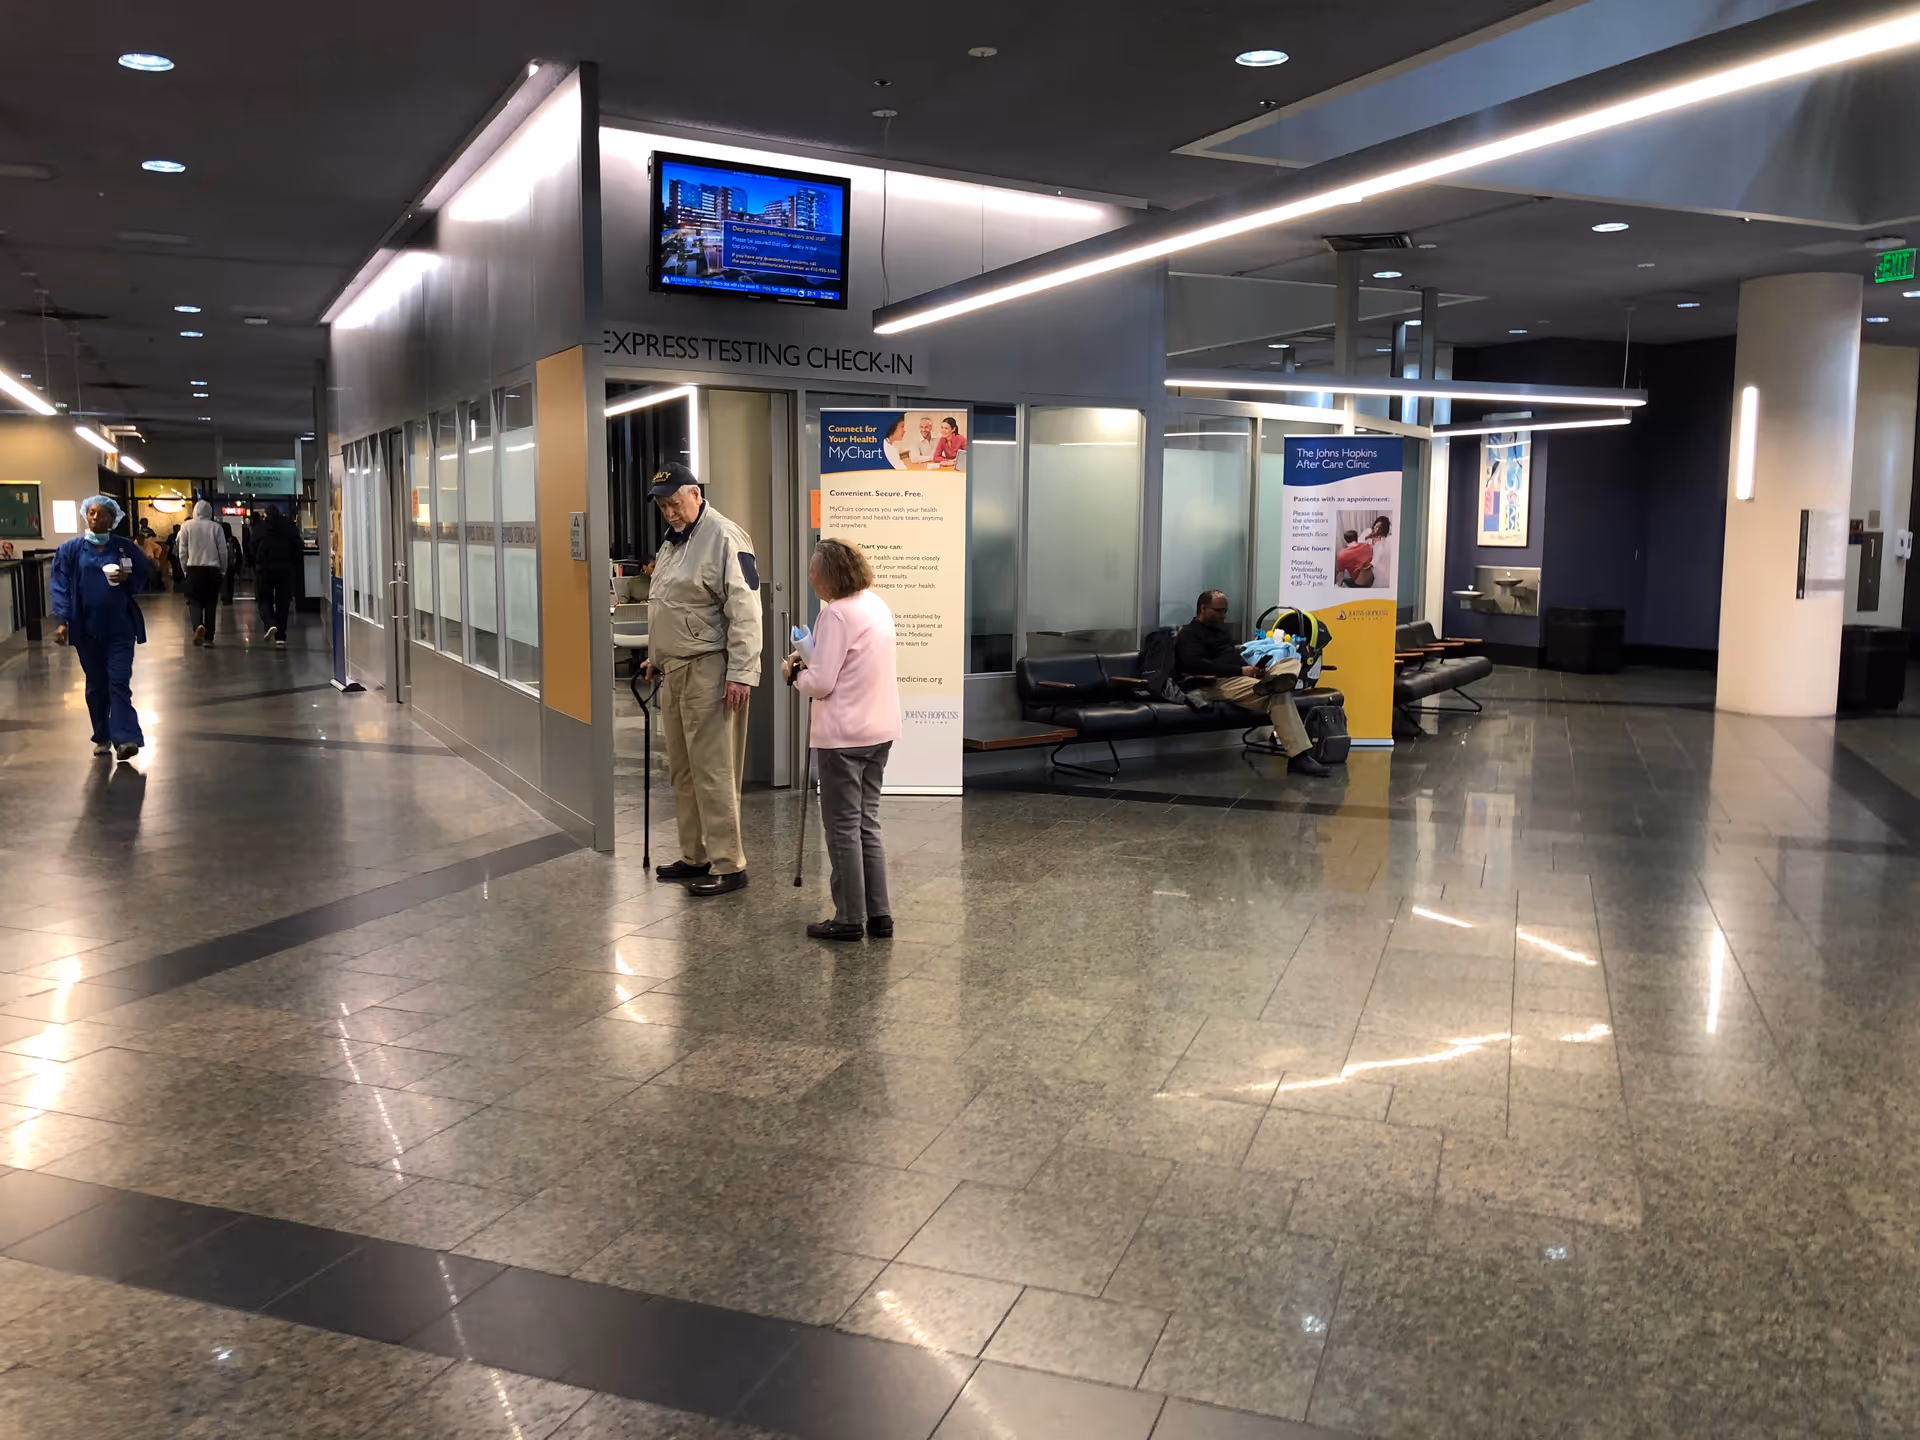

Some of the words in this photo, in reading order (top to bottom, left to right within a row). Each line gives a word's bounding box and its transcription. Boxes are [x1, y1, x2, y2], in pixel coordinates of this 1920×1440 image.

[1883, 252, 1909, 278] EXIT
[604, 330, 699, 360] EXPRESS
[702, 338, 800, 367] TESTING
[807, 346, 913, 376] CHECK-IN
[828, 446, 883, 462] MyChart
[1296, 448, 1314, 458] The
[1316, 448, 1340, 459] Johns
[1342, 448, 1377, 459] Hopkins
[1296, 460, 1320, 468] After
[1322, 460, 1344, 468] Care
[1346, 460, 1370, 468] Clinic
[896, 676, 943, 685] medicine.org
[904, 711, 927, 720] JOHNS
[928, 711, 959, 720] HOPKINS
